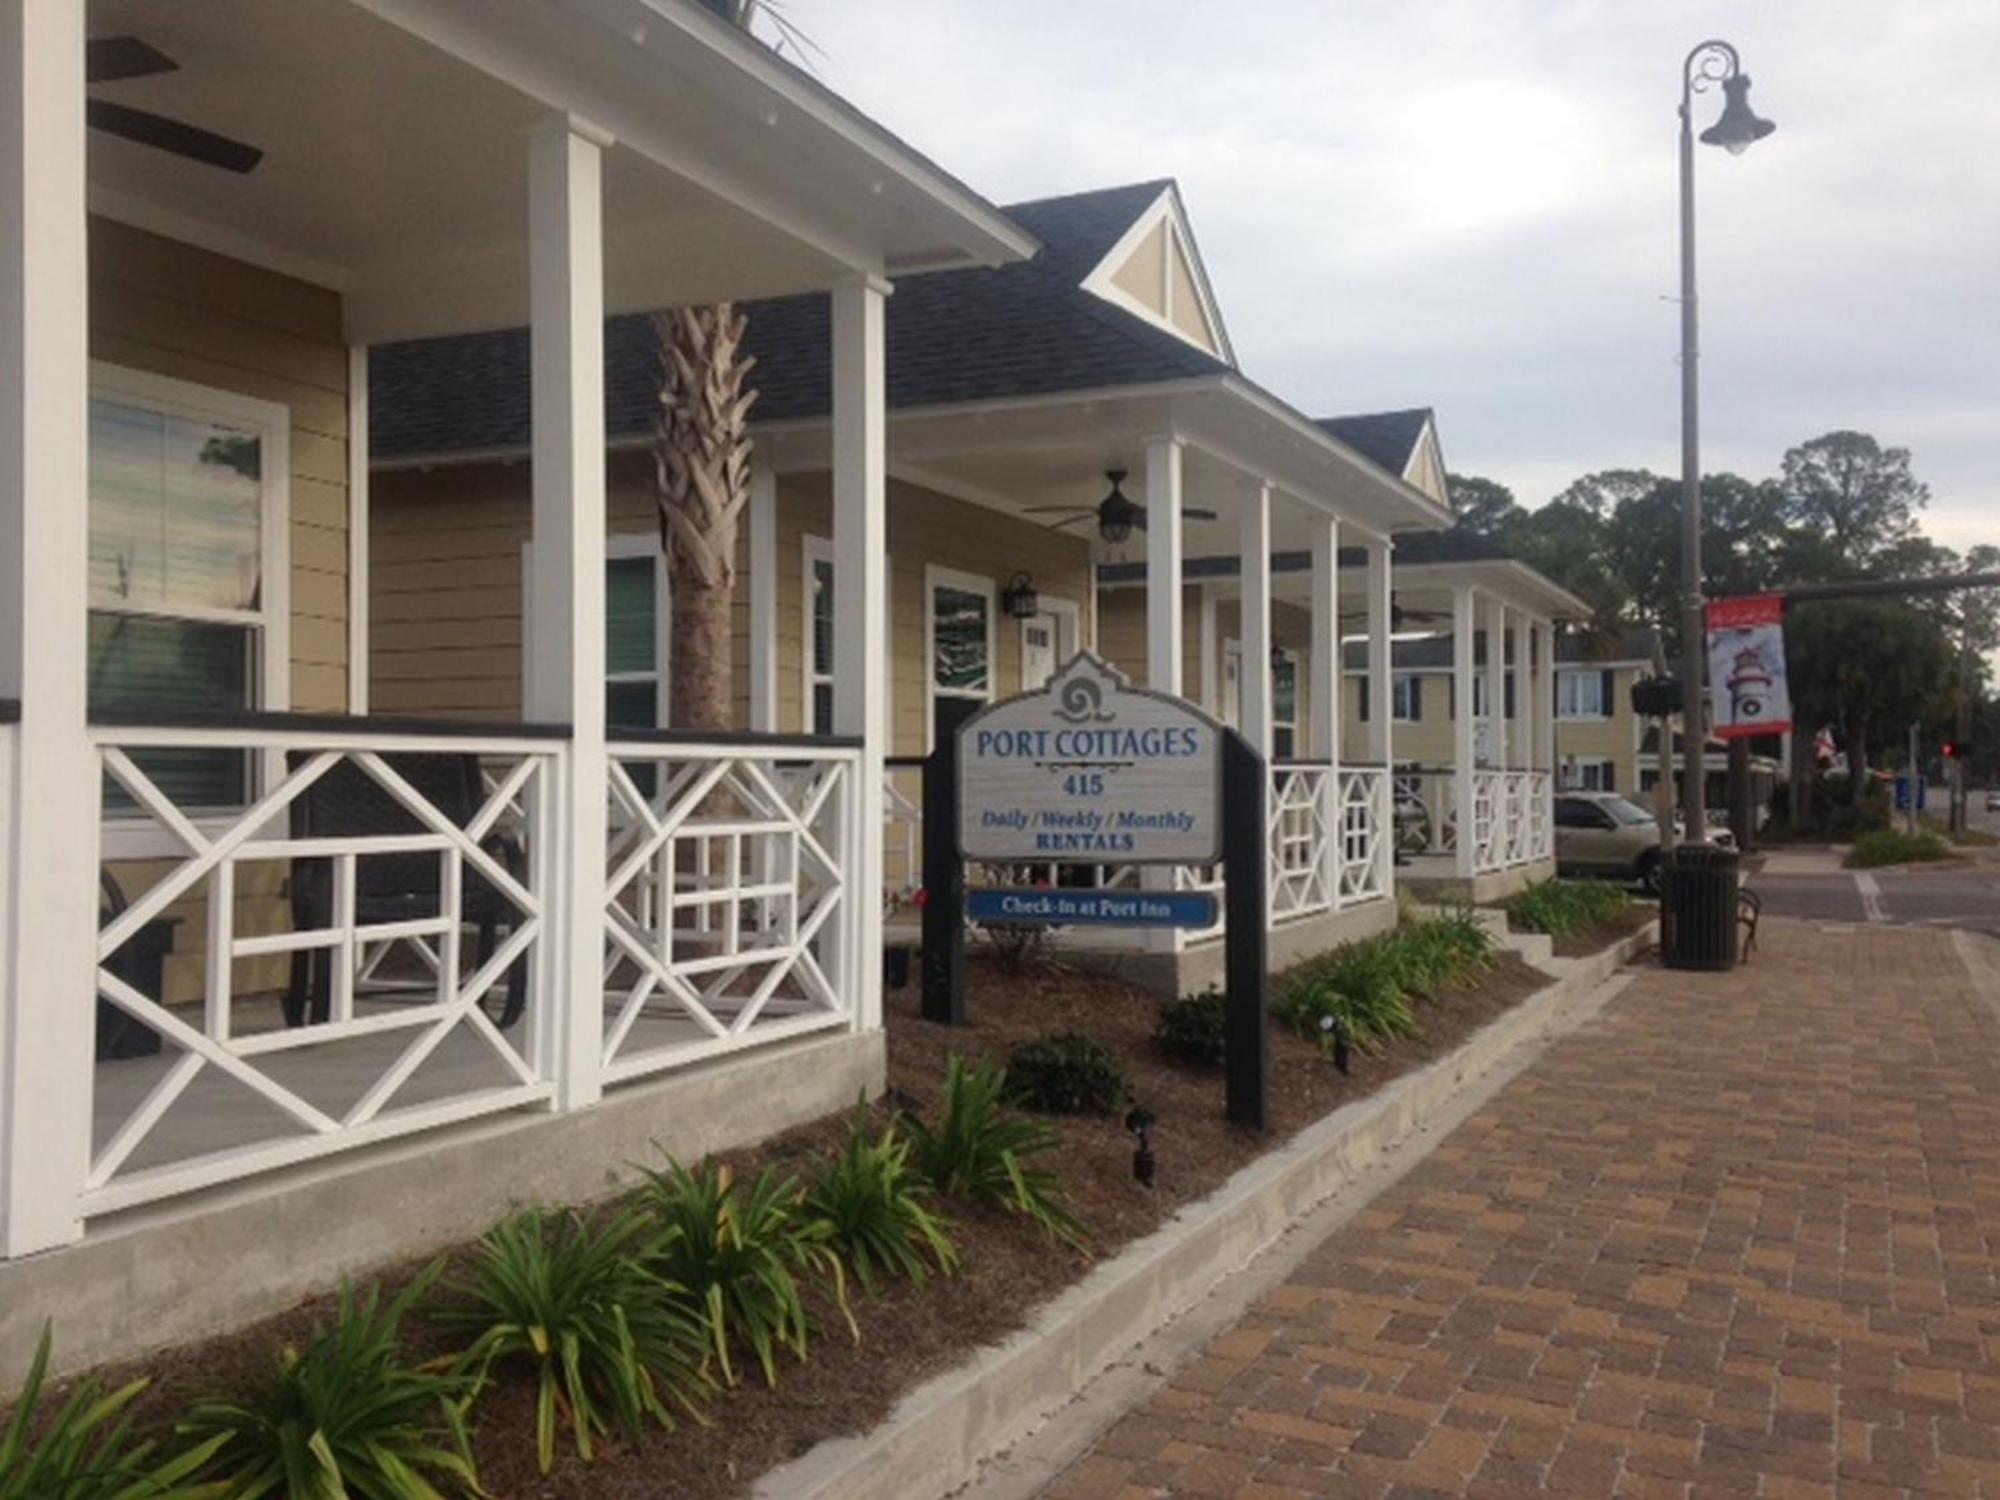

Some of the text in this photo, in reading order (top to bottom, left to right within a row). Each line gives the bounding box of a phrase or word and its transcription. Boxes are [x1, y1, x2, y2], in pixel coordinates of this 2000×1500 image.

[977, 728, 1198, 757] PORT COTTAGES
[1063, 774, 1104, 796] 415
[981, 811, 1028, 830] Daily
[1042, 811, 1103, 831] Weekly
[1116, 811, 1195, 832] Monthly
[1036, 834, 1134, 850] RENTALS
[1079, 900, 1097, 915] at
[1100, 899, 1137, 917] Port
[1141, 900, 1172, 917] Inn
